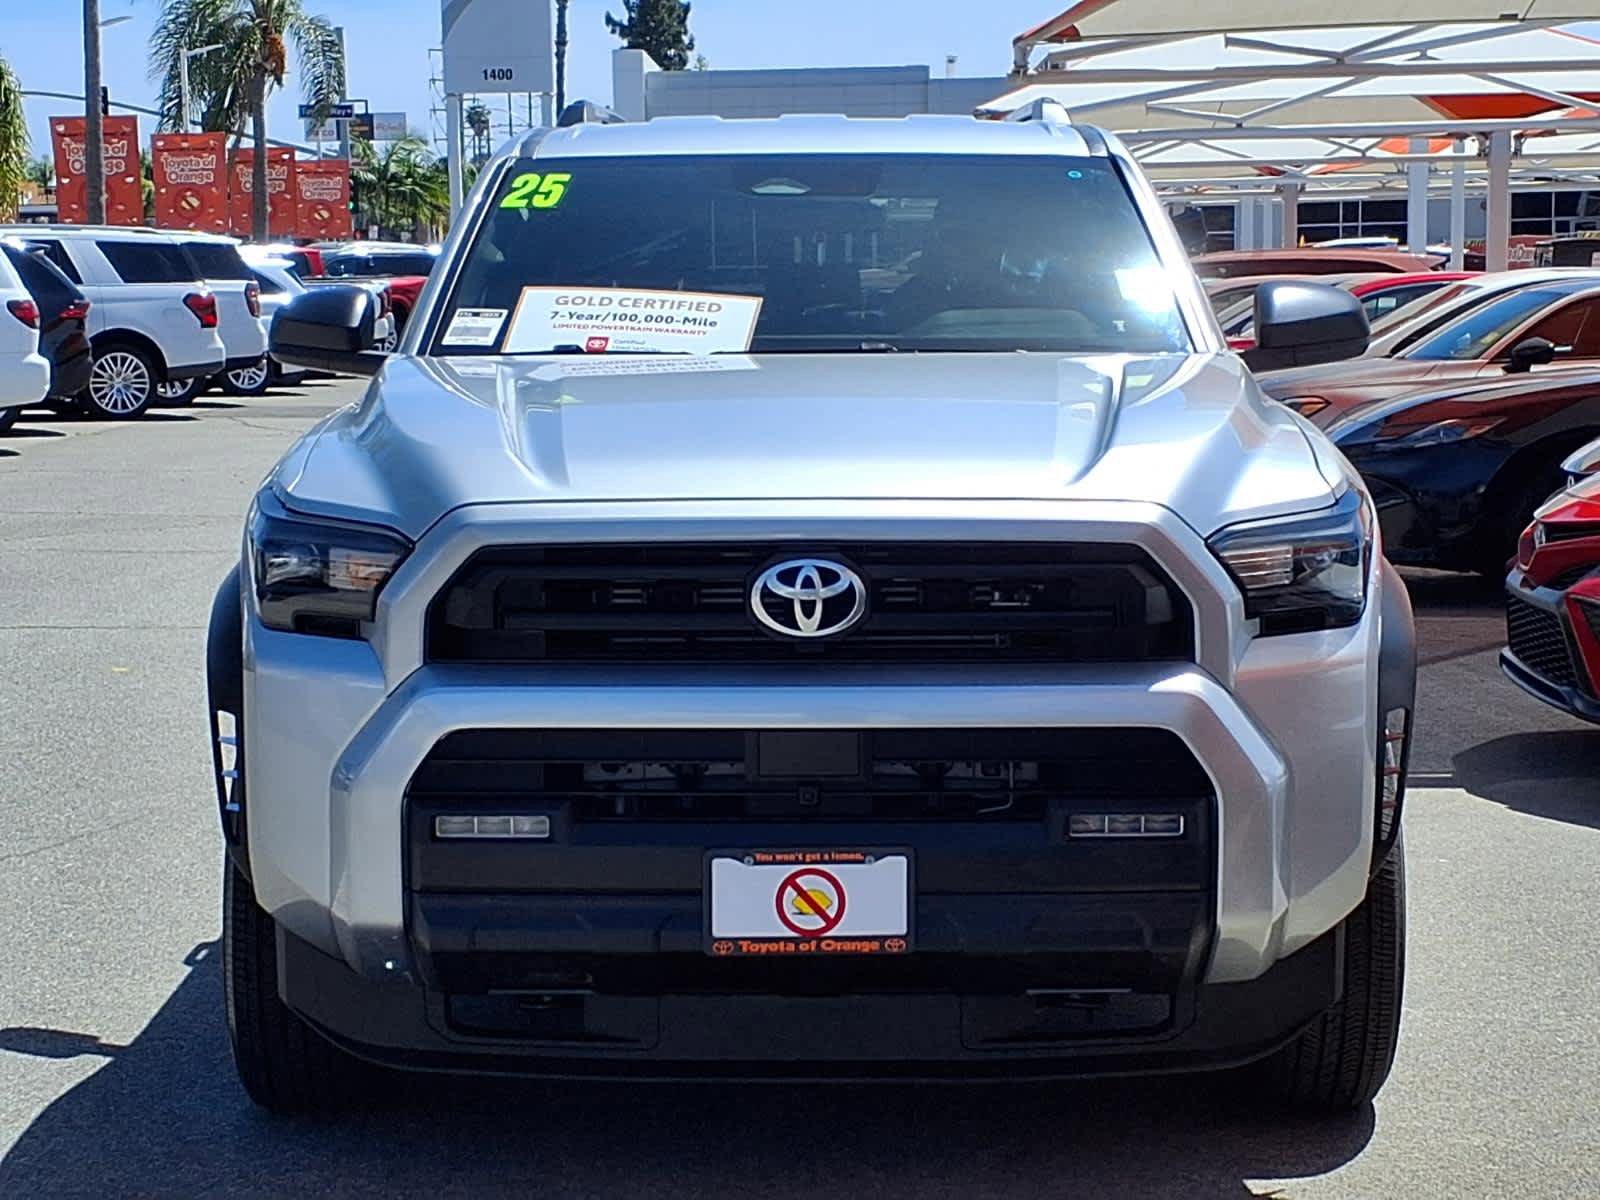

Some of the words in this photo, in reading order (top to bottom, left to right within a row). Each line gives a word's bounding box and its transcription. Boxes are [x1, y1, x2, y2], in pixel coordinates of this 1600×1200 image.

[482, 68, 513, 80] 1400
[111, 141, 127, 156] of
[70, 158, 125, 174] Oge
[161, 155, 201, 170] Toyota
[203, 155, 215, 169] of
[168, 170, 213, 183] Orange
[500, 173, 573, 208] 25
[555, 295, 614, 307] GOLD
[618, 297, 723, 313] CERTIFIED
[550, 310, 719, 328] 7-Year/100,000-Mile
[552, 322, 590, 330] LIMITED
[591, 324, 653, 332] POWERTRAIN
[655, 326, 708, 336] WARRANTY
[755, 853, 773, 862] You
[776, 852, 803, 862] won't
[805, 853, 821, 863] get
[823, 853, 830, 861] a
[737, 940, 795, 954] Toyota
[799, 940, 817, 951] of
[820, 939, 881, 953] Orange
